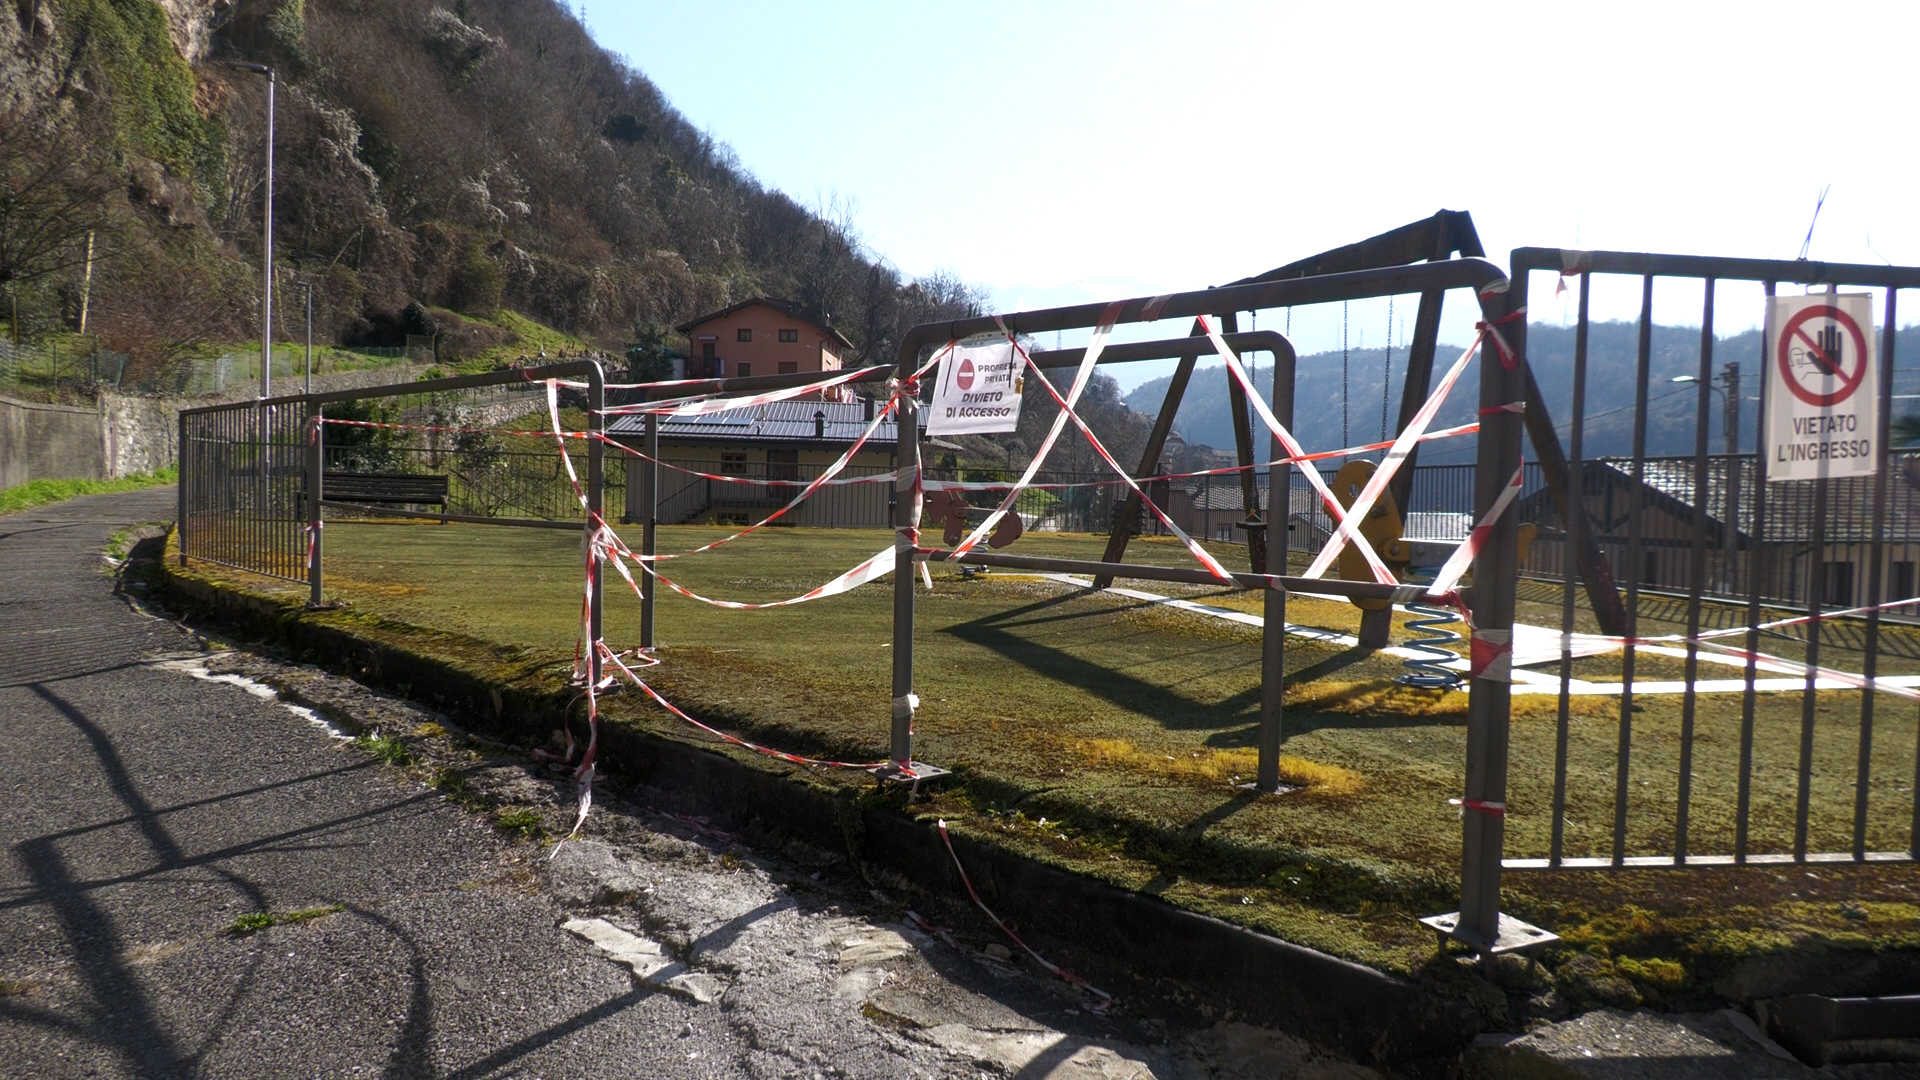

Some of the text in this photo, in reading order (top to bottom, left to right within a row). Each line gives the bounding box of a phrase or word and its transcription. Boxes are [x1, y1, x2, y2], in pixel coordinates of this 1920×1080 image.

[962, 391, 1003, 403] DIVIETO
[946, 407, 1010, 418] DI ACCESSO
[1793, 414, 1856, 435] VIETATO
[1778, 440, 1870, 462] L'INGRESSO
